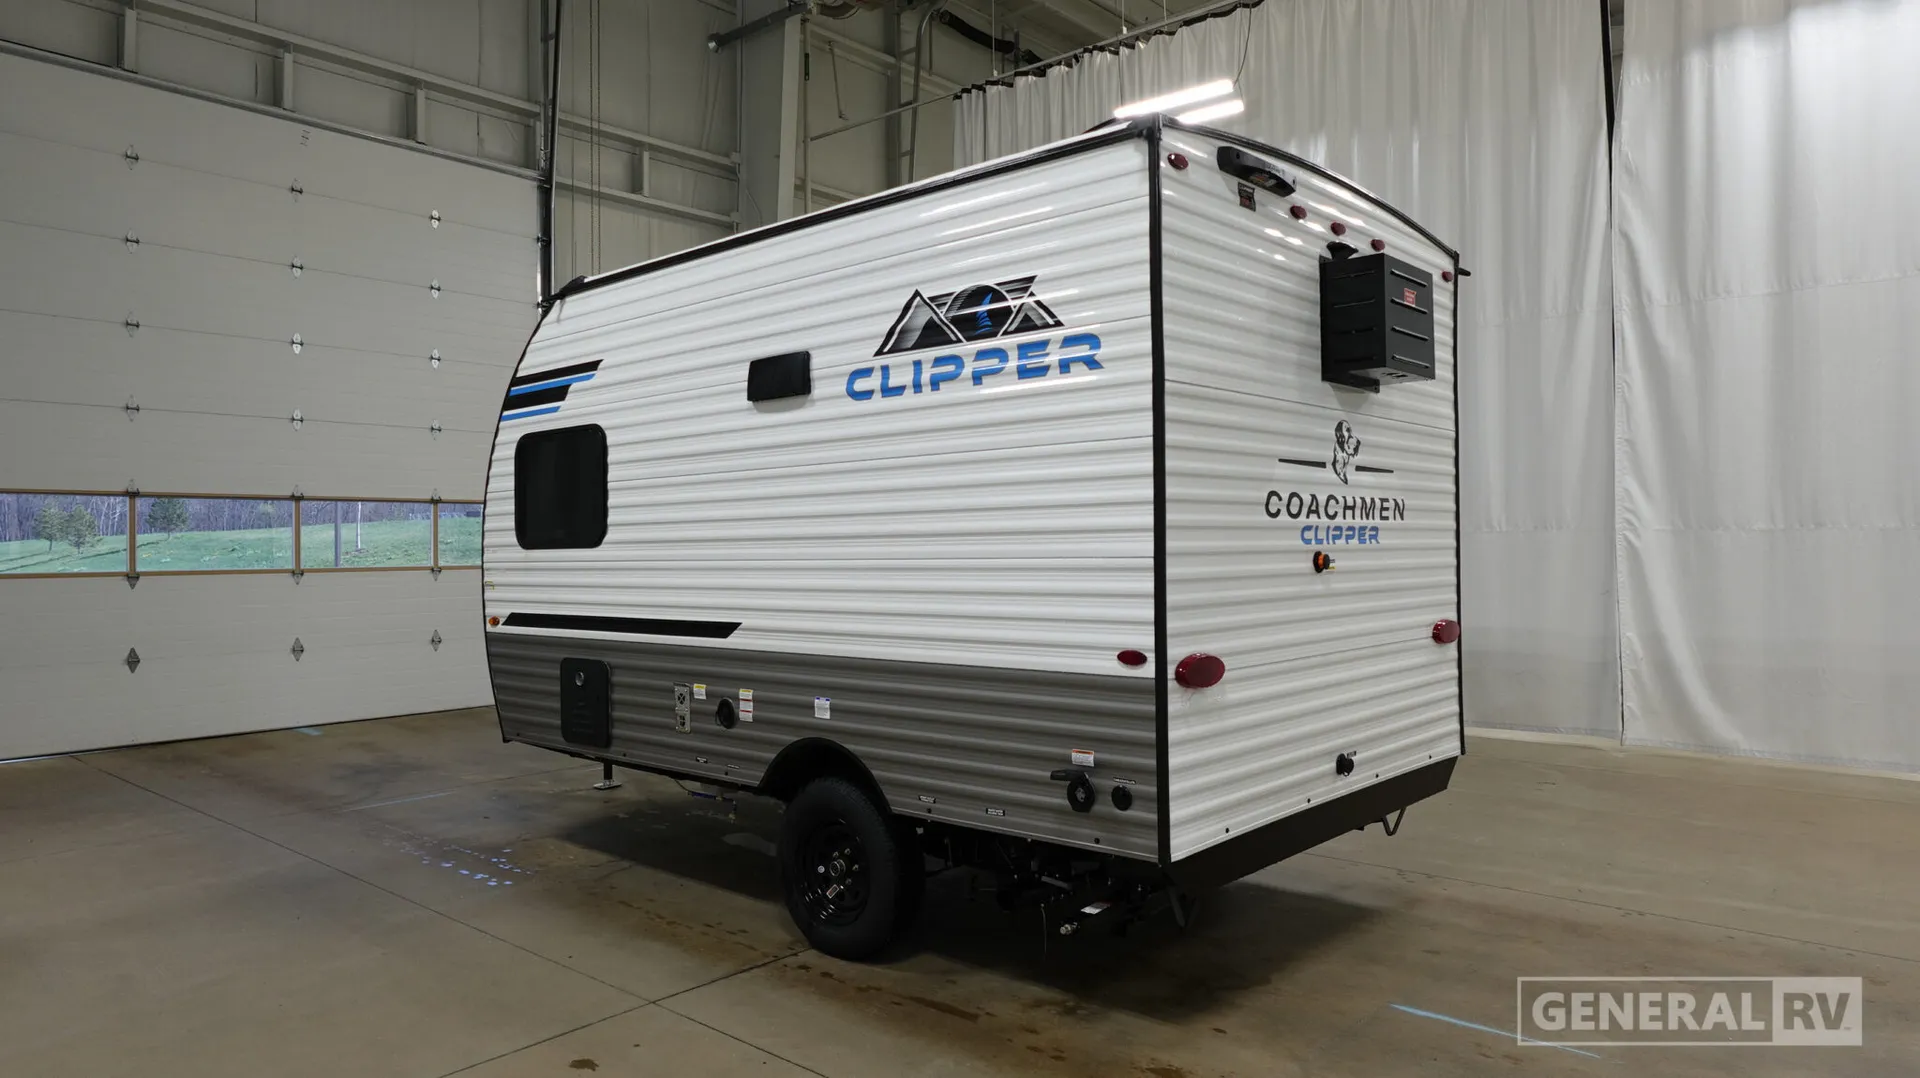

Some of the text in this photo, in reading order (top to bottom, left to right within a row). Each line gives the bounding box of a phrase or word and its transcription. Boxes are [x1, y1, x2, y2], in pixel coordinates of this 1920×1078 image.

[846, 333, 1104, 401] CLIPPER
[1265, 490, 1405, 521] COACHMEN
[1301, 525, 1380, 545] CLIPPER
